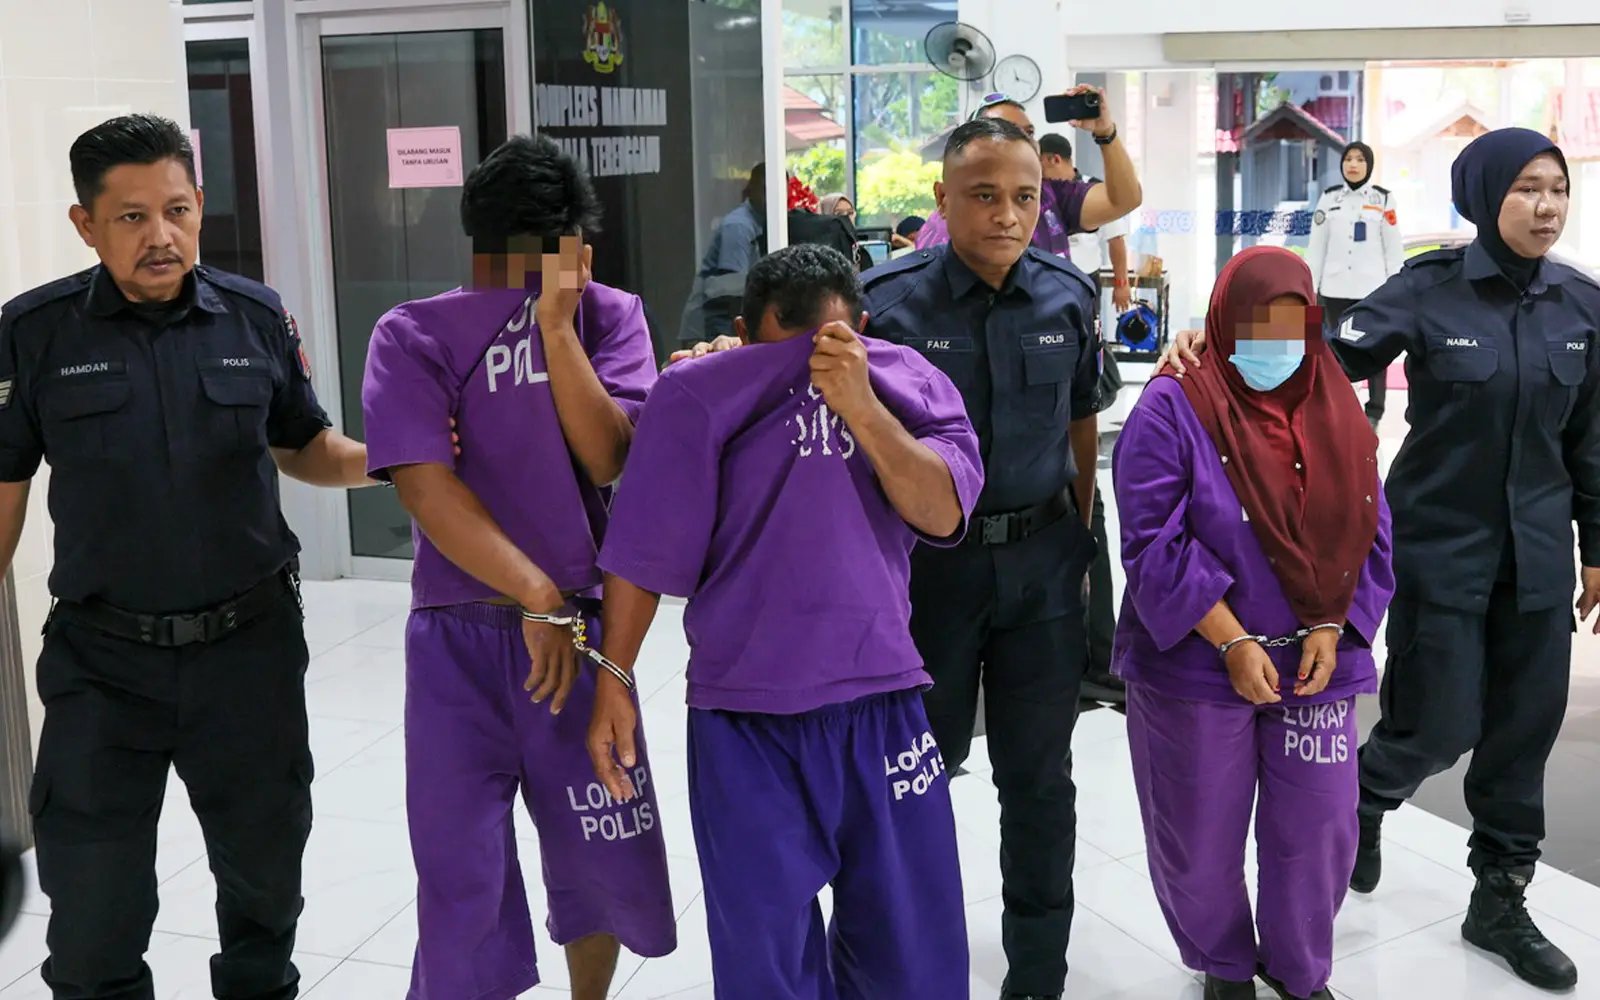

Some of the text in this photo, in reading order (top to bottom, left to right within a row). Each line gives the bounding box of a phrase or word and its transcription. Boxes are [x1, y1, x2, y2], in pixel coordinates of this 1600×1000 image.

[397, 148, 428, 156] DILARANG
[927, 340, 951, 349] FAIZ
[1039, 334, 1065, 345] POLIS
[1446, 338, 1479, 348] NABILA
[60, 362, 109, 376] HAMDAN
[223, 358, 250, 367] POLIS
[485, 335, 549, 393] POL
[1282, 700, 1349, 730] LOKAP
[1284, 729, 1349, 763] POLIS
[883, 731, 937, 777] LOKA
[580, 802, 654, 841] POLIS
